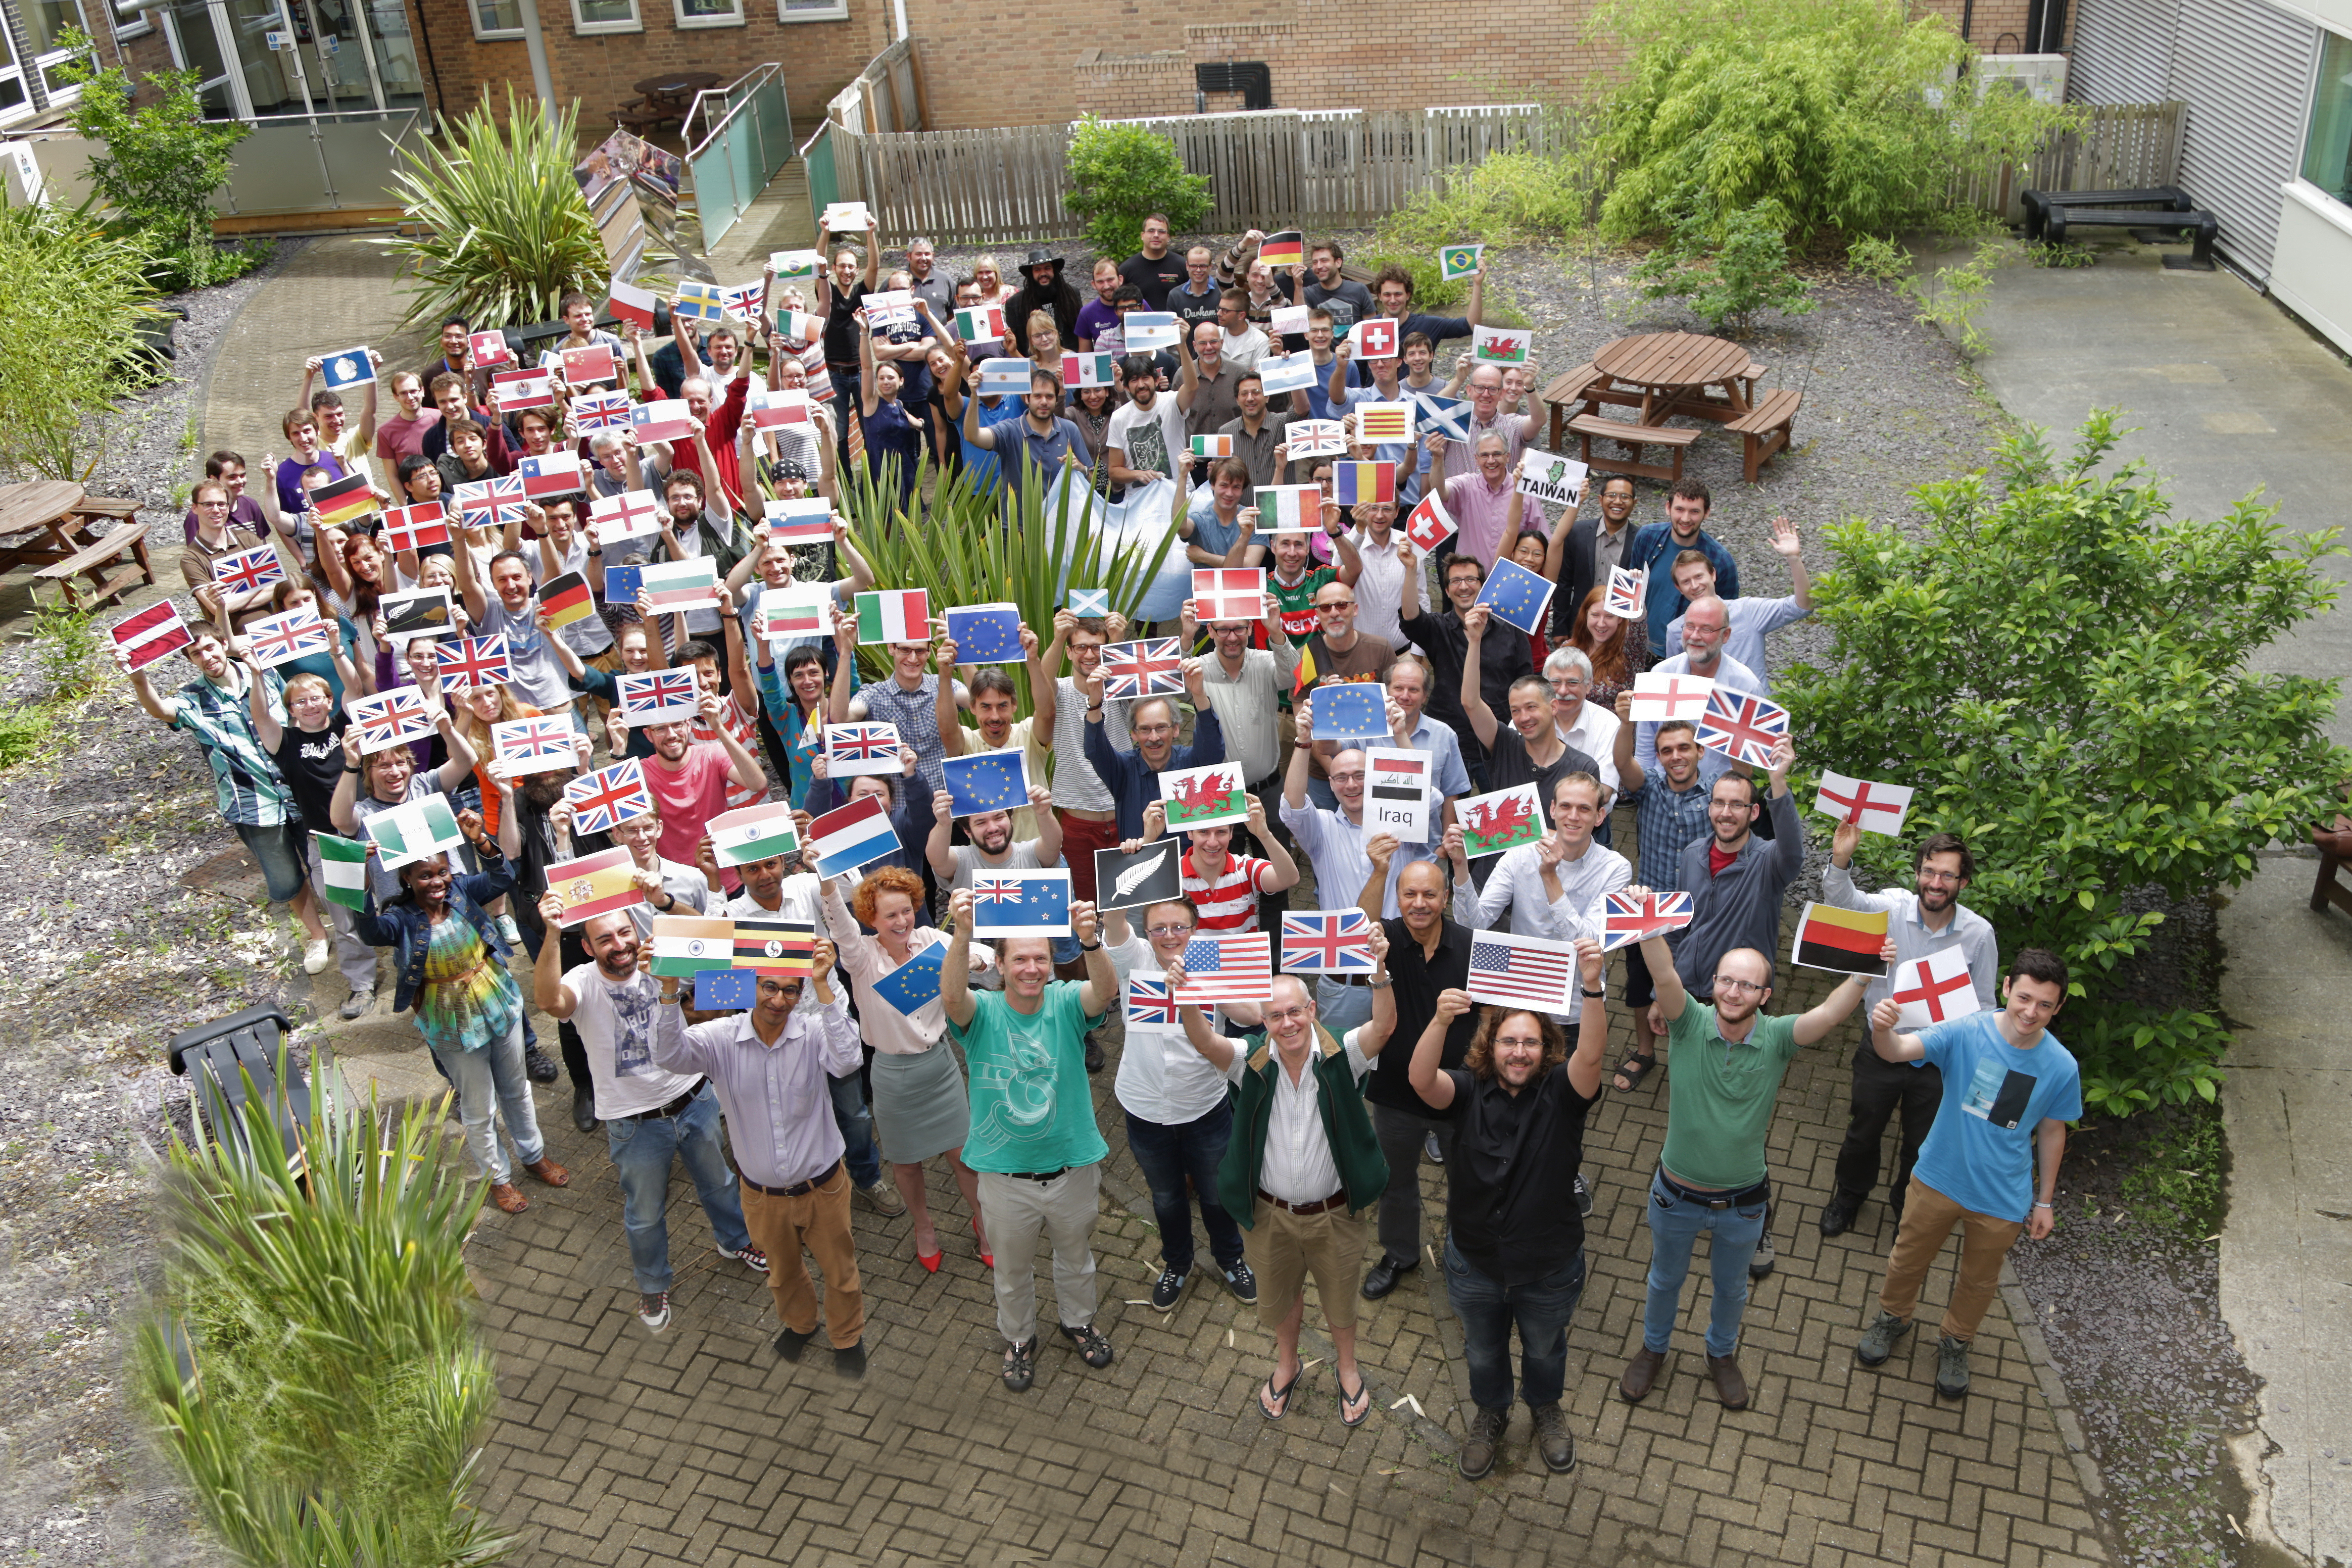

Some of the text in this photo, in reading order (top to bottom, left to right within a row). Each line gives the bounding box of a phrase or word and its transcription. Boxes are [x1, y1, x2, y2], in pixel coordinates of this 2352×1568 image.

[1183, 306, 1217, 318] Durham
[1523, 477, 1578, 504] TAIWAN
[1280, 615, 1320, 632] lverys
[1380, 774, 1413, 785] الله أكبر
[1380, 807, 1412, 827] Iraq
